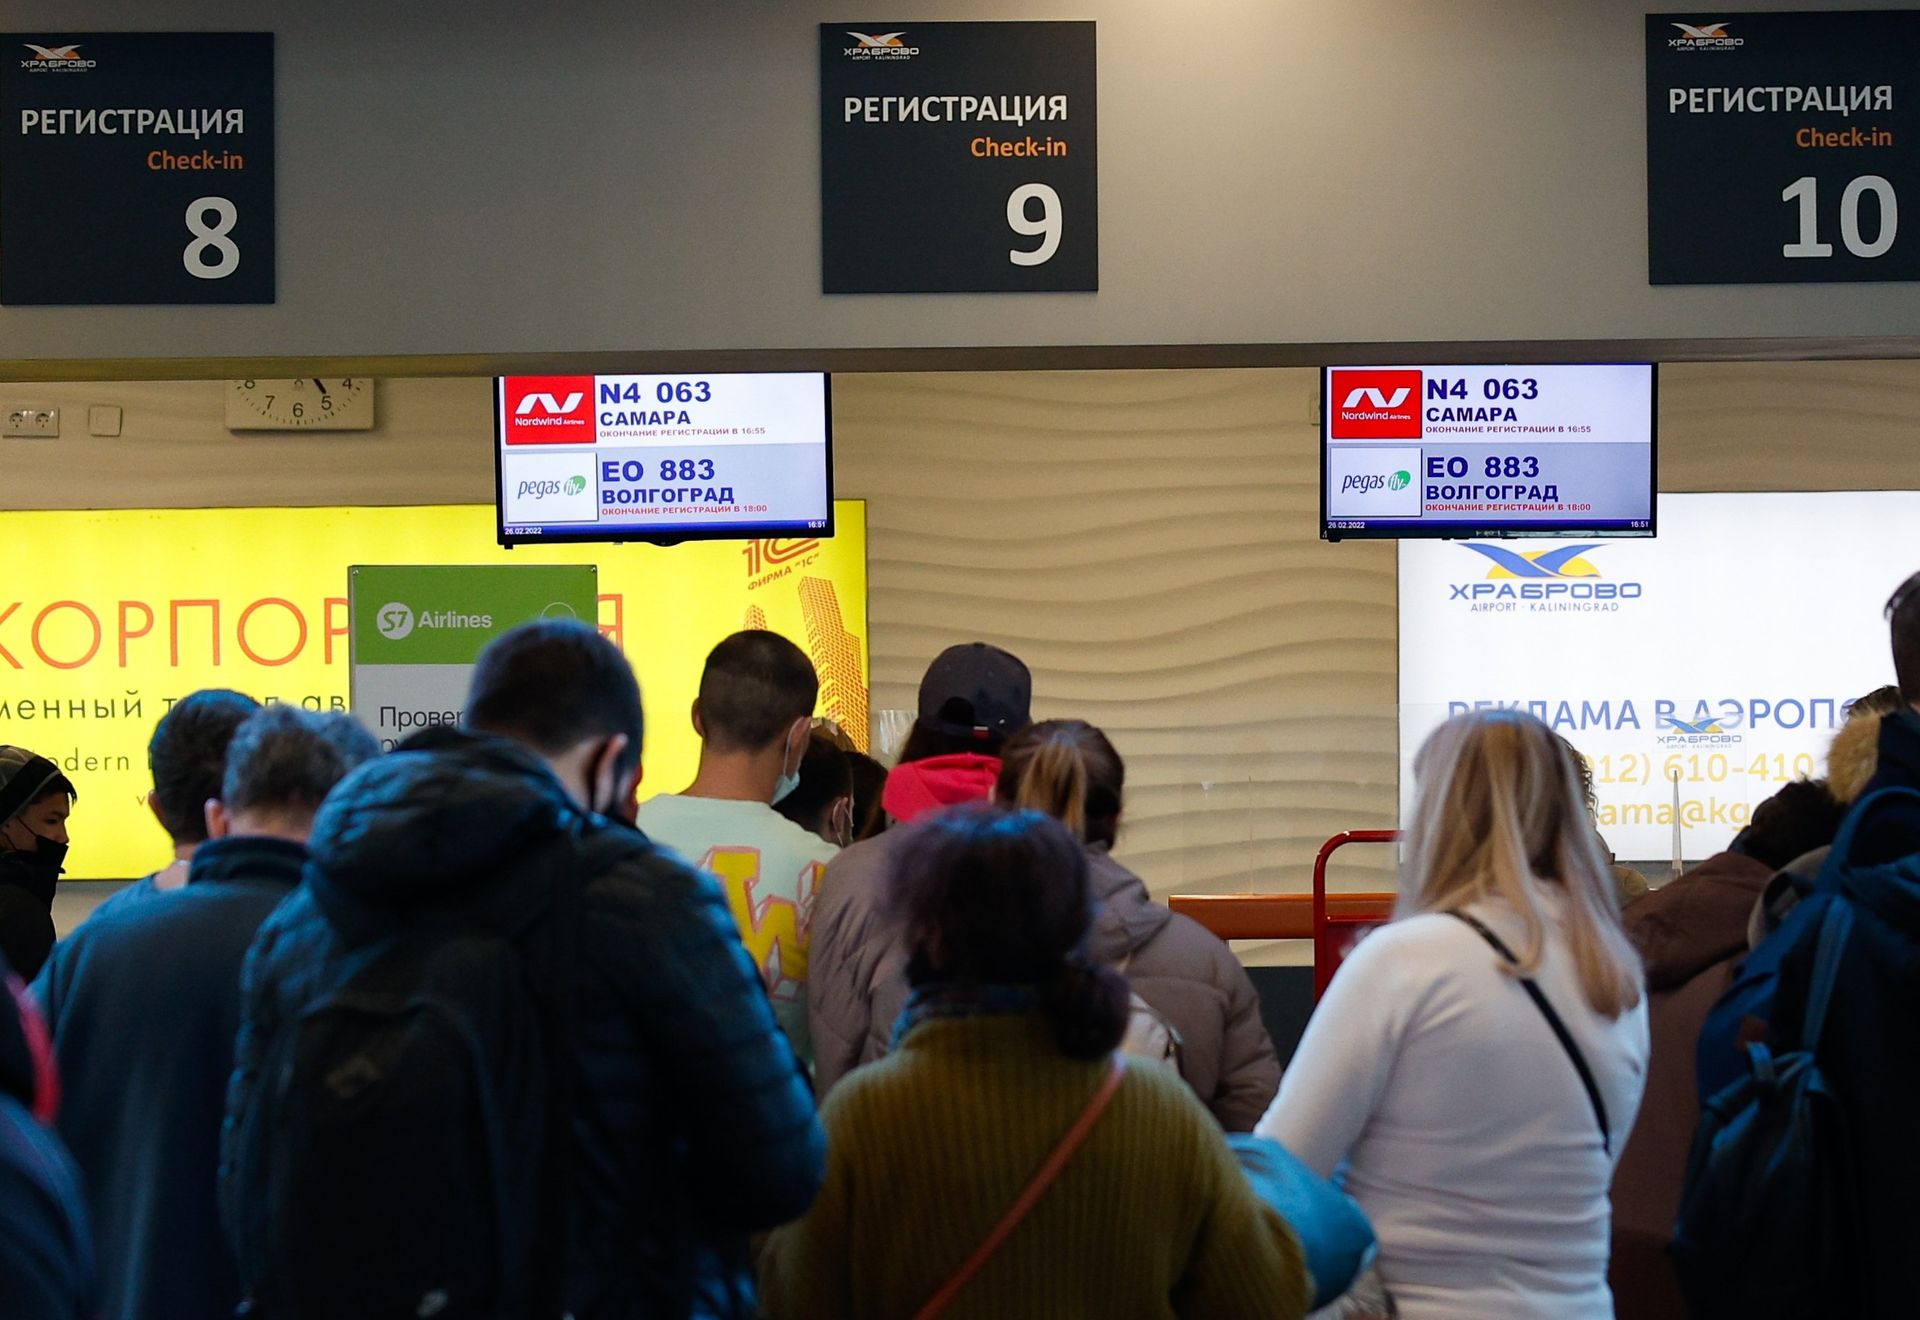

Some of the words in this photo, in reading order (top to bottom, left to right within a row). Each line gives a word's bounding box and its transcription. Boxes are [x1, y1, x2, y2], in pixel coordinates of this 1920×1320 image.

[1668, 38, 1744, 47] ХРАБРОВО
[843, 47, 919, 56] ХРАБРОВО
[20, 60, 96, 68] ХРАБРОВО
[1668, 85, 1892, 117] РЕГИСТРАЦИЯ
[844, 95, 1067, 127] РЕГИСТРАЦИЯ
[21, 109, 244, 139] РЕГИСТРАЦИЯ
[1795, 127, 1892, 148] Check-in
[970, 136, 1067, 157] Check-in
[147, 150, 243, 170] Check-in
[1006, 182, 1063, 266] 9
[1781, 174, 1899, 258] 10
[183, 196, 240, 279] 8
[600, 382, 641, 405] N4
[656, 381, 711, 403] 063
[1427, 378, 1468, 400] N4
[1483, 378, 1538, 400] 063
[265, 395, 275, 410] 7
[292, 402, 304, 417] 6
[321, 396, 332, 410] 5
[515, 417, 562, 426] Nordwind
[600, 410, 691, 426] САМАРА
[1341, 411, 1389, 420] Nordwind
[1426, 407, 1517, 422] САМАРА
[600, 430, 657, 438] ОКОНЧАНИЕ
[660, 428, 729, 437] РЕГИСТРАЦИИ
[742, 427, 765, 435] 16:55
[1486, 426, 1555, 434] РЕГИСТРАЦИИ
[1567, 425, 1591, 433] 16:55
[602, 460, 644, 482] EO
[659, 459, 715, 481] 883
[1427, 456, 1468, 478] EO
[1484, 456, 1539, 478] 883
[517, 480, 560, 500] pegas
[1341, 474, 1385, 494] pegas
[602, 487, 735, 504] ВОЛГОГРАД
[1426, 485, 1558, 503] ВОЛГОГРАД
[602, 507, 660, 515] ОКОНЧАНИЕ
[662, 505, 731, 514] РЕГИСТРАЦИИ
[743, 505, 767, 513] 18:00
[1486, 504, 1555, 512] РЕГИСТРАЦИИ
[504, 527, 542, 535] 26.02.2022
[1327, 521, 1365, 529] 26.02.2022
[748, 566, 792, 591] ФИРМА
[1449, 583, 1641, 600] ХРАБРОВО
[1470, 602, 1516, 612] AIRPORT
[1530, 602, 1619, 612] KALININGRAD
[382, 611, 408, 632] S7
[418, 611, 493, 629] Airlines
[1655, 700, 1675, 729] В
[1657, 735, 1742, 744] ХРАБРОВО
[48, 747, 129, 771] dern
